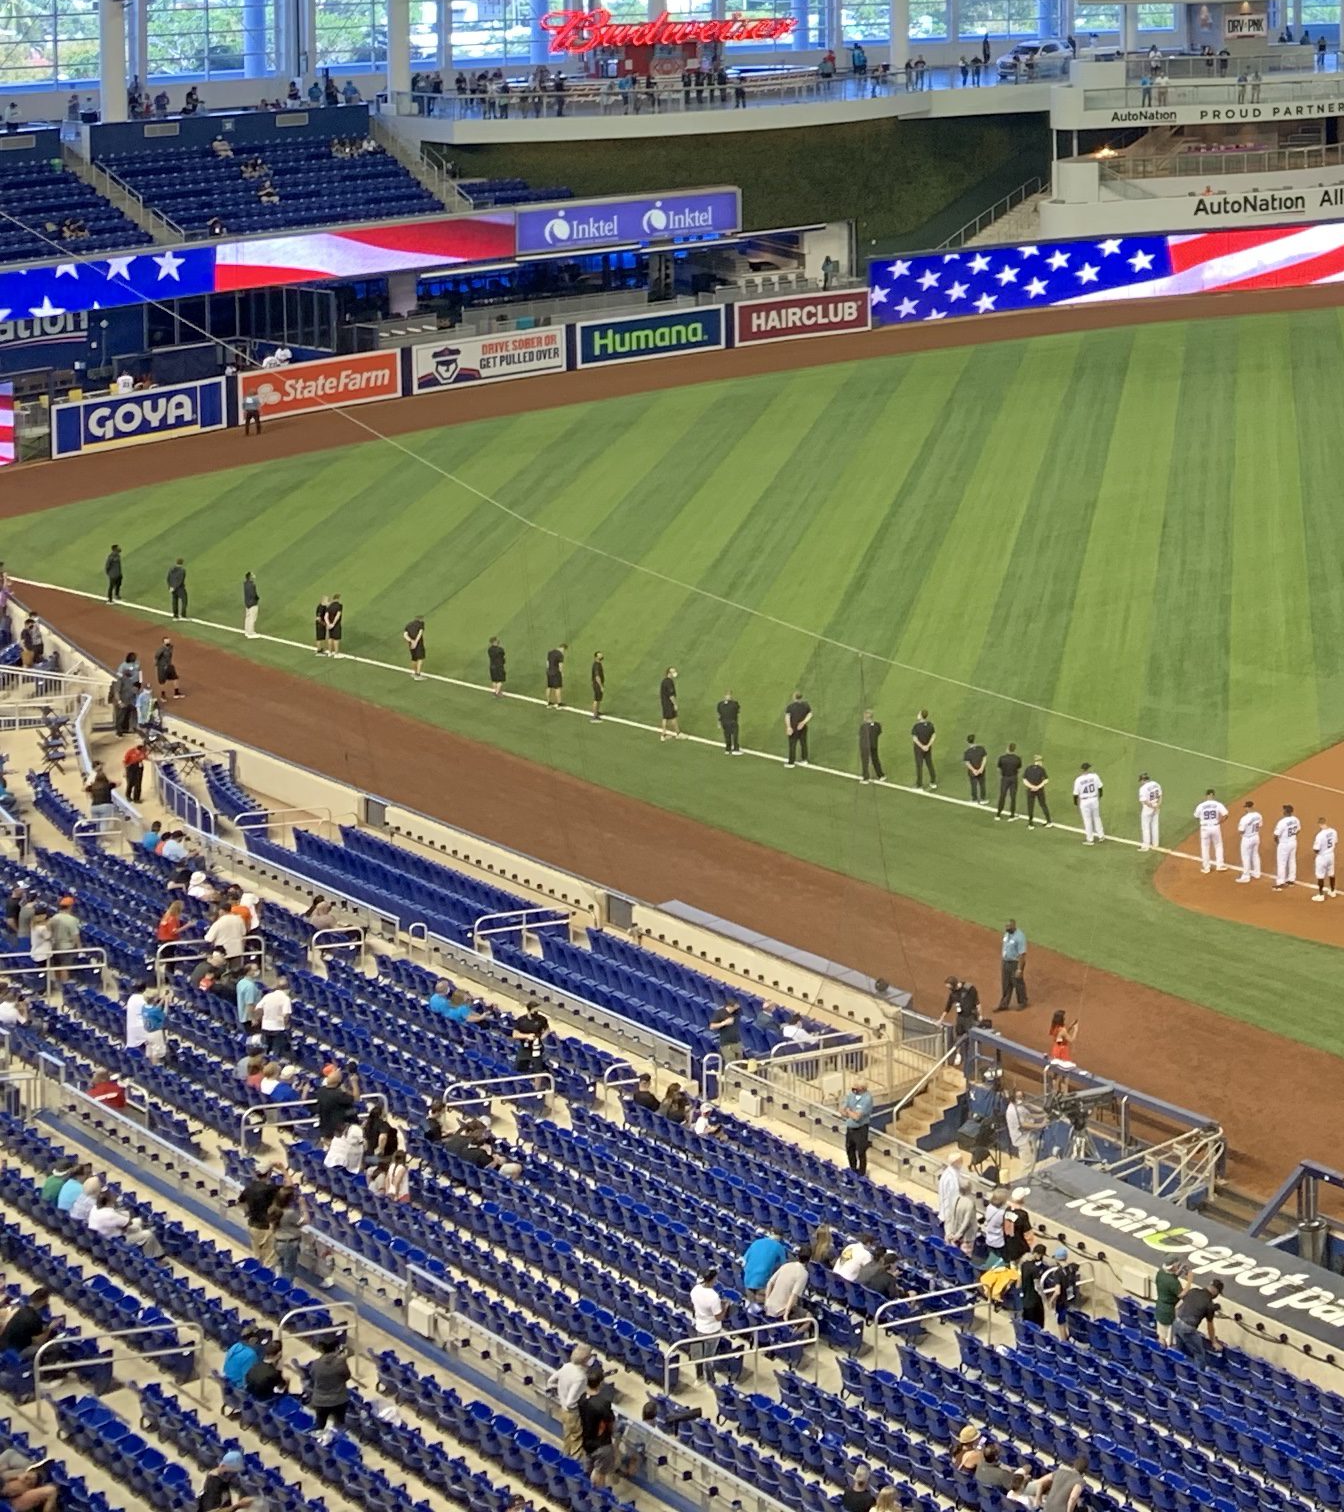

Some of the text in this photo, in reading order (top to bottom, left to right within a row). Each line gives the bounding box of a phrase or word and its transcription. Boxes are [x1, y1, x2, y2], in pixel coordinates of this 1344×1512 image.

[539, 8, 799, 54] Budweiser
[1111, 110, 1177, 122] AutoNation
[1200, 108, 1262, 120] PROUD
[1194, 194, 1305, 216] AutoNation
[572, 215, 618, 240] Inktel
[669, 206, 713, 229] Inktel
[751, 302, 858, 333] HAIRCLUB
[482, 334, 557, 356] DRIVE SOBER OR
[480, 347, 560, 370] GET PULLED OVER
[88, 394, 193, 440] GOYA
[1065, 1189, 1310, 1296] loanDepot
